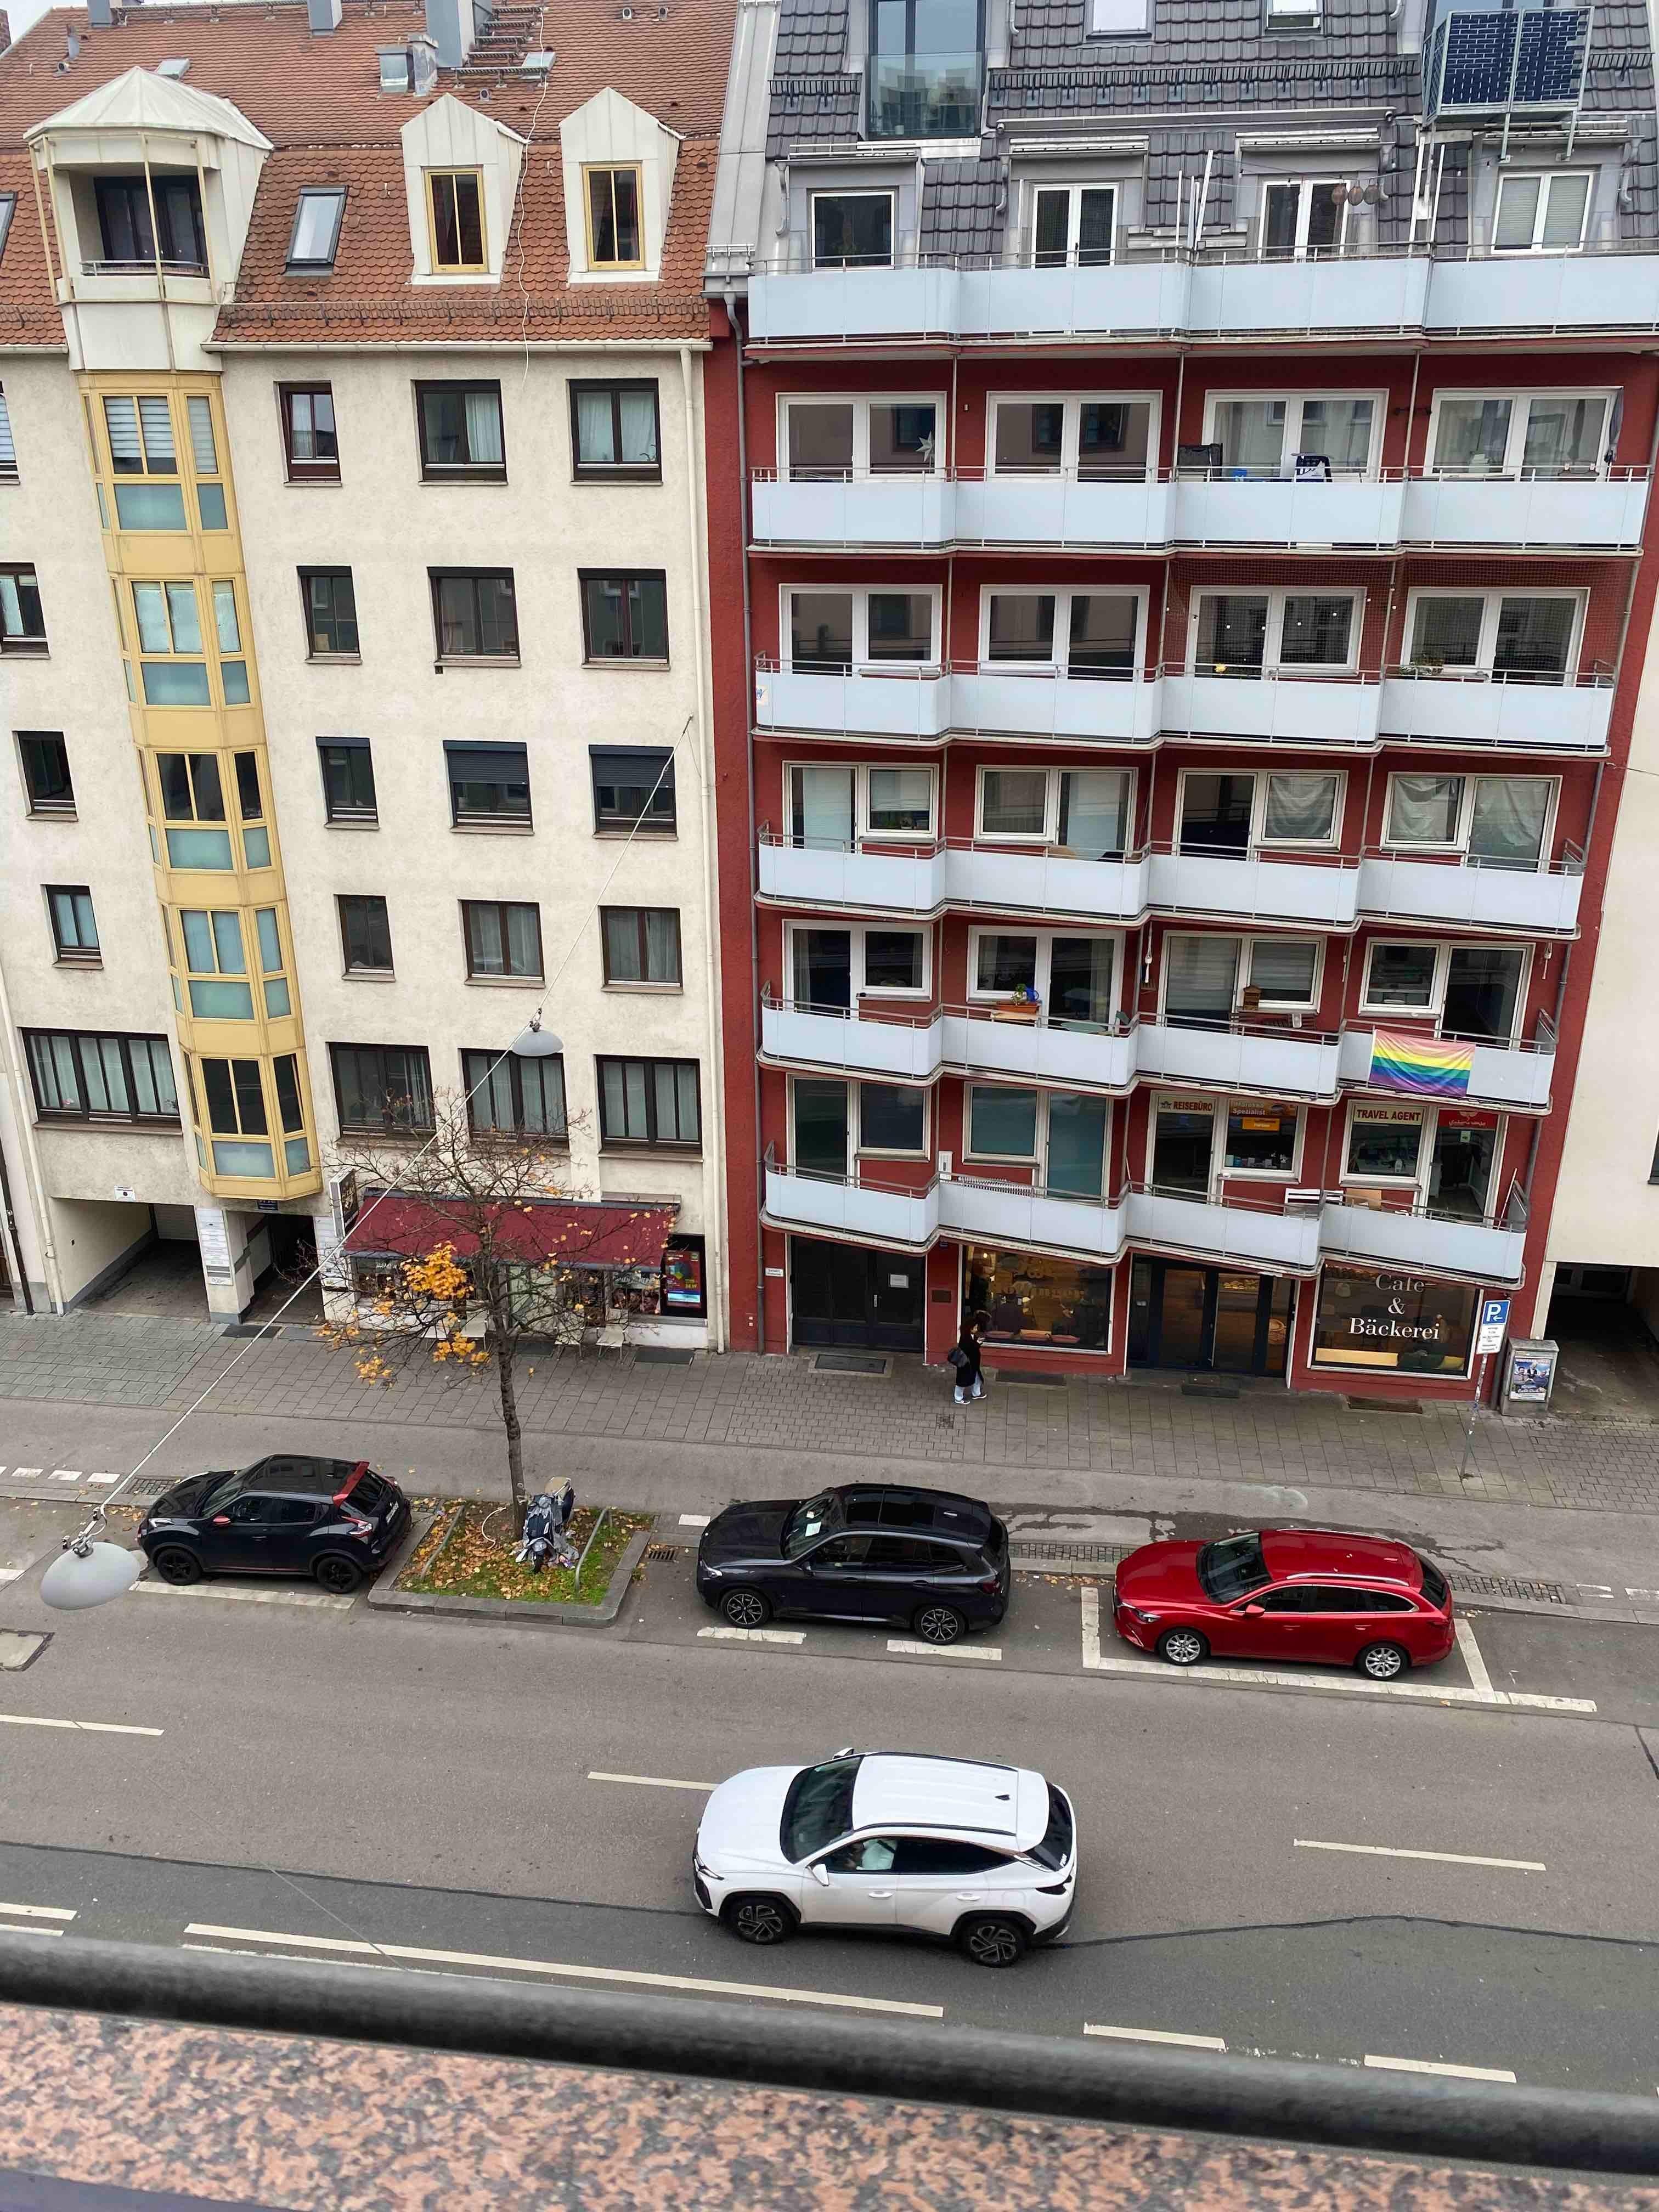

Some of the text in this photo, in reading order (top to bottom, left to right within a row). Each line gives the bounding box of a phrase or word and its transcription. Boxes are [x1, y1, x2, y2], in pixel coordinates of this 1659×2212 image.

[1174, 1101, 1212, 1111] REISEBÜRO
[1357, 1109, 1420, 1121] TRAVEL AGENT
[1388, 1297, 1405, 1314] &
[1486, 1304, 1502, 1322] P
[1348, 1317, 1440, 1339] Bäckerei
